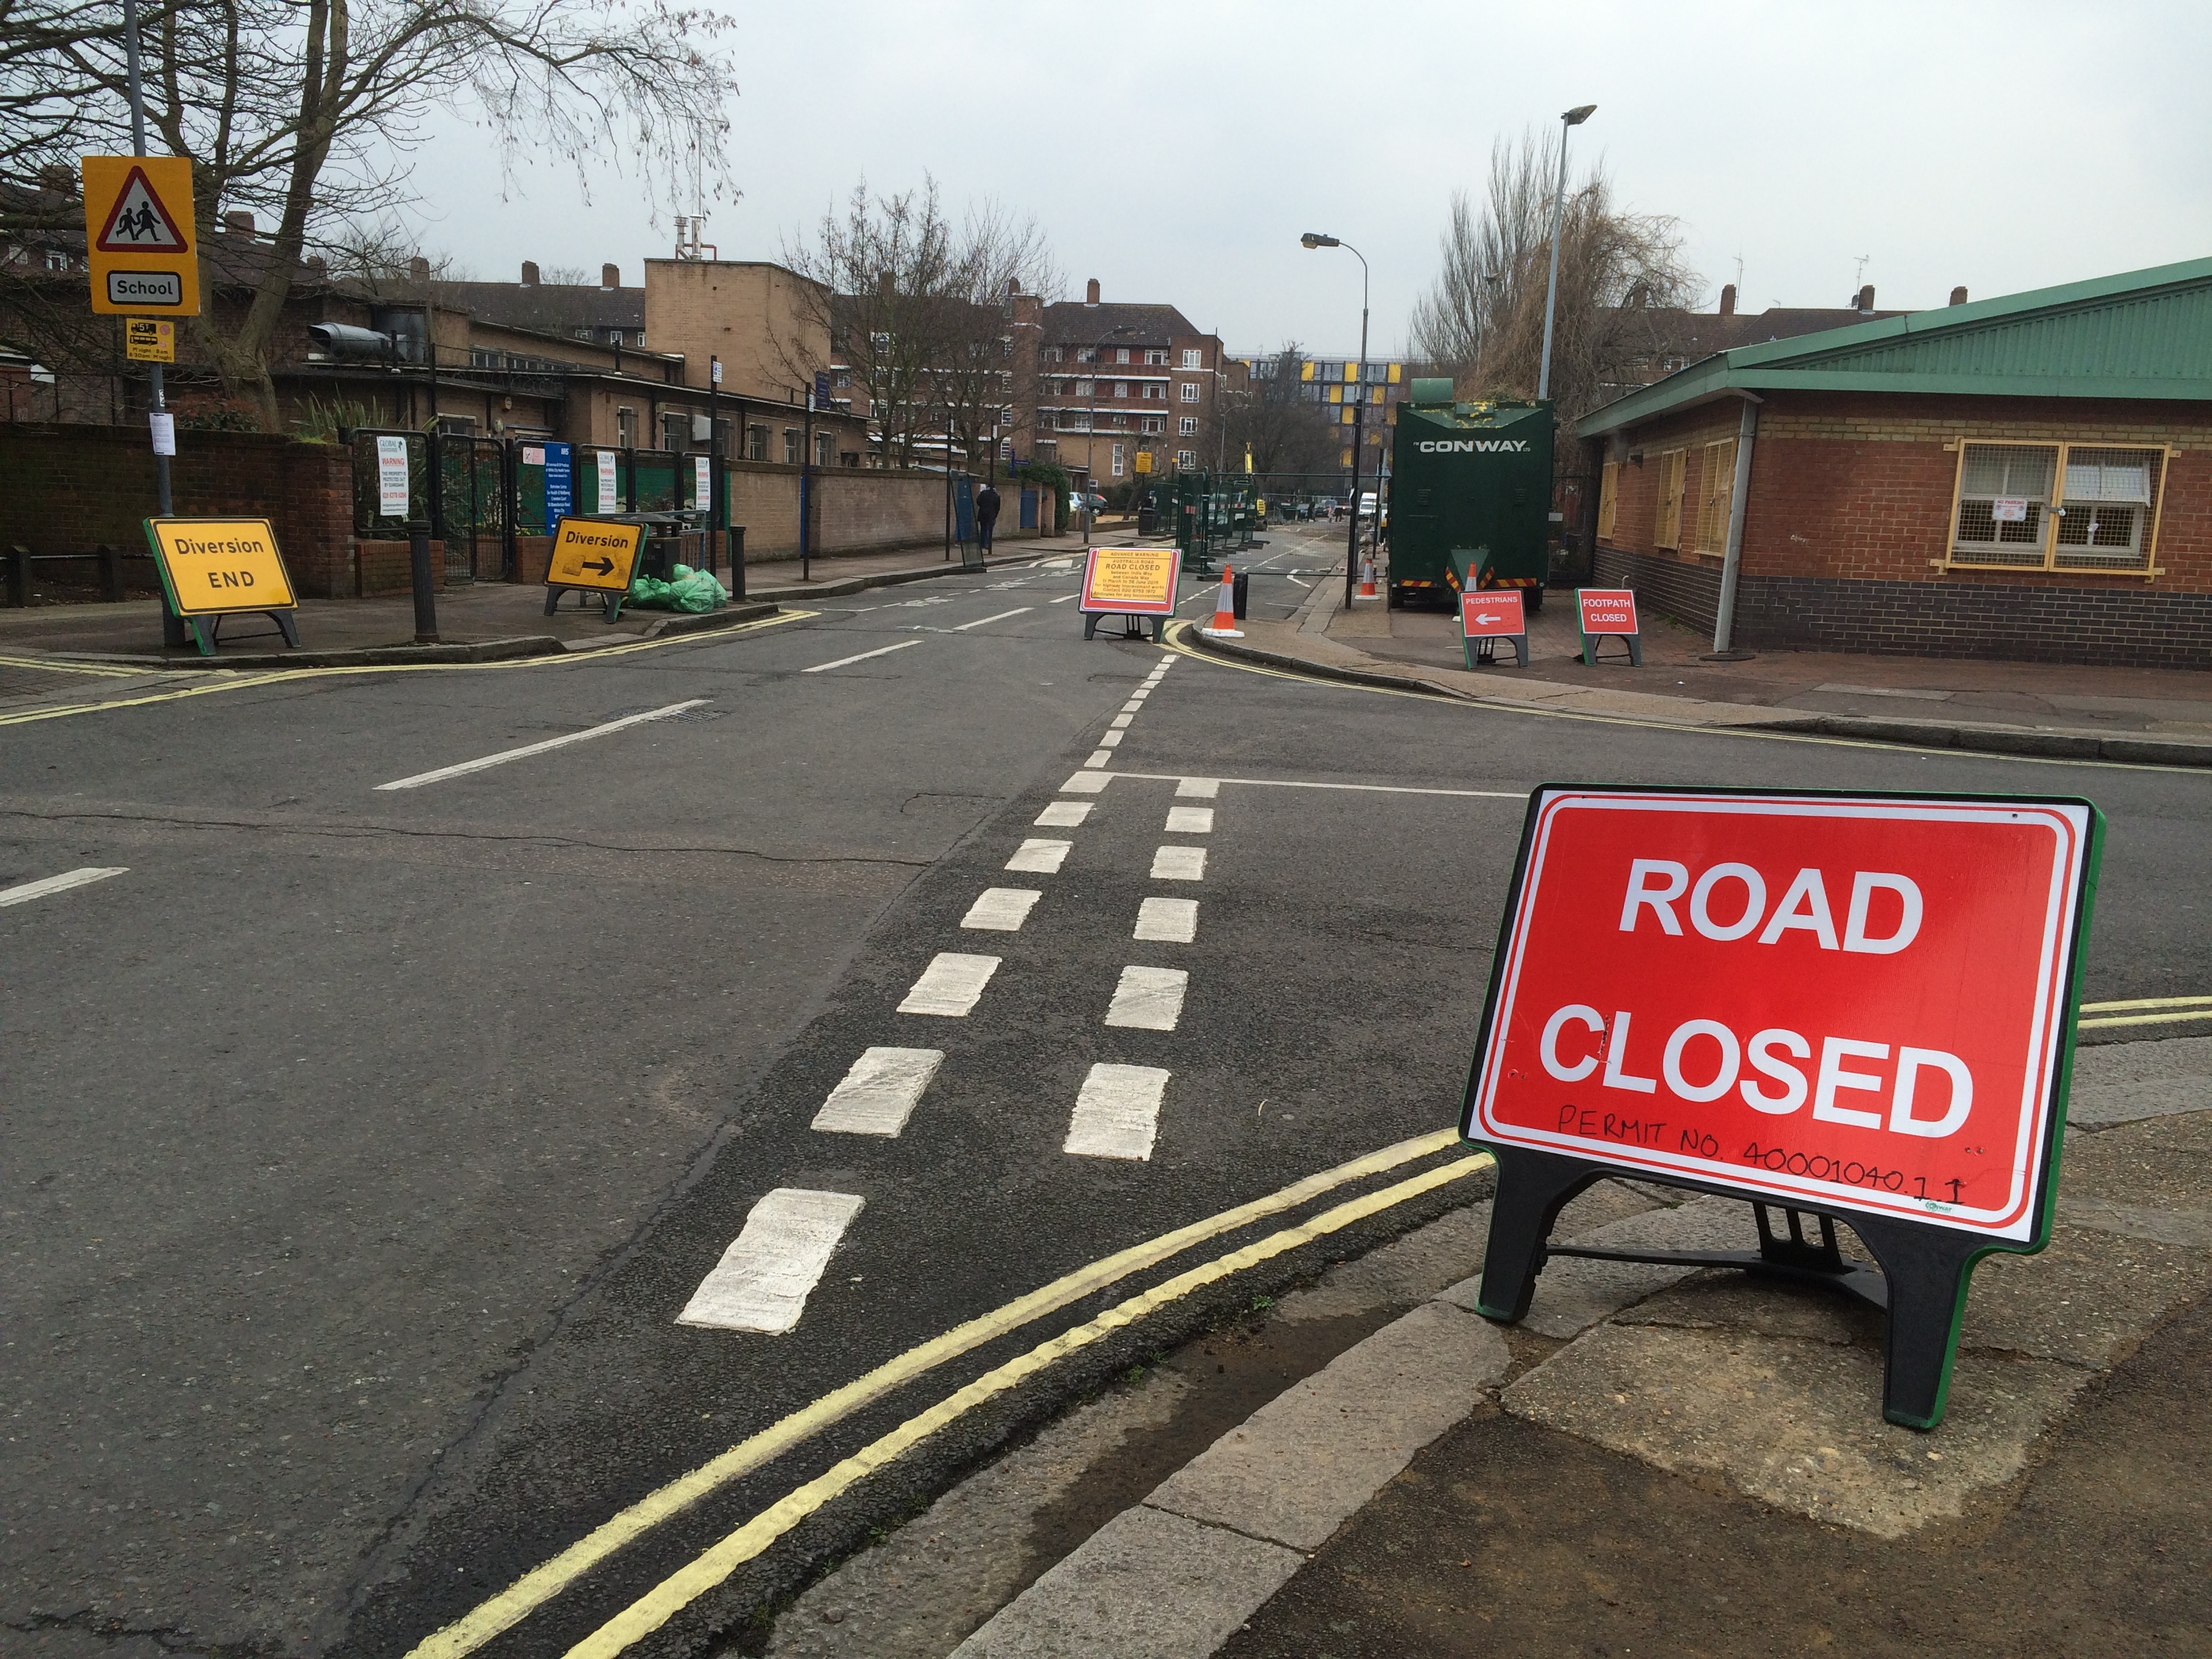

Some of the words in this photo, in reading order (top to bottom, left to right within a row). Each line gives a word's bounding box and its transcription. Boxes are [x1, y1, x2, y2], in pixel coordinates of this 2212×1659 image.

[117, 280, 173, 295] School
[1420, 441, 1528, 453] CONWAY
[174, 537, 264, 554] Diversion
[565, 531, 629, 549] Diversion
[207, 571, 254, 588] END
[1466, 596, 1518, 605] PEDESTRIANS
[1583, 598, 1631, 608] FOOTPATH
[1591, 613, 1627, 622] CLOSED
[1618, 858, 1923, 955] ROAD
[1539, 1004, 1973, 1139] CLOSED
[1558, 1105, 1667, 1143] PERMIT
[1680, 1129, 1723, 1160] NO.
